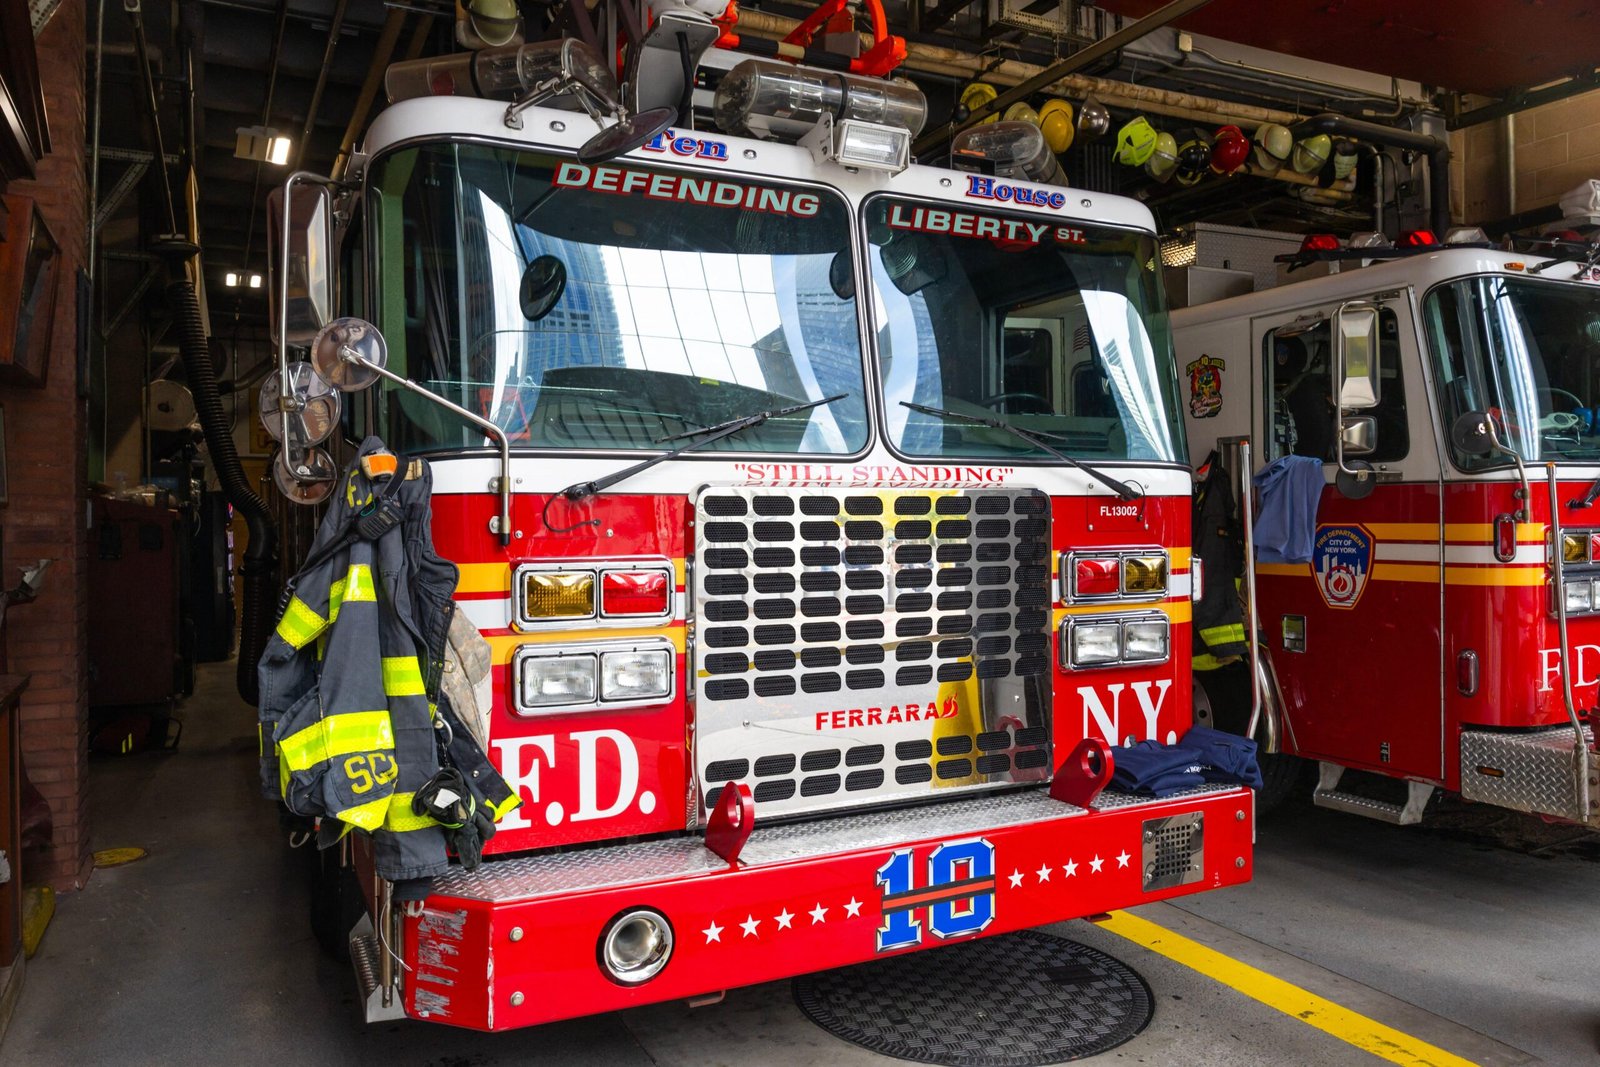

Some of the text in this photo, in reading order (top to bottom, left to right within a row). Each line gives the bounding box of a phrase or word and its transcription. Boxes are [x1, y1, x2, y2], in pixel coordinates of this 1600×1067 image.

[641, 129, 729, 161] Ten
[556, 162, 820, 216] DEFENDING
[966, 175, 1066, 209] House
[890, 205, 1087, 243] LIBERTY ST.
[734, 463, 1014, 483] "STILL STANDING"
[1100, 505, 1138, 517] FL13002
[1316, 529, 1366, 549] FIRE DEPARTMENT
[815, 701, 940, 731] FERRARA
[491, 728, 657, 832] F.D.
[876, 836, 996, 953] 10
